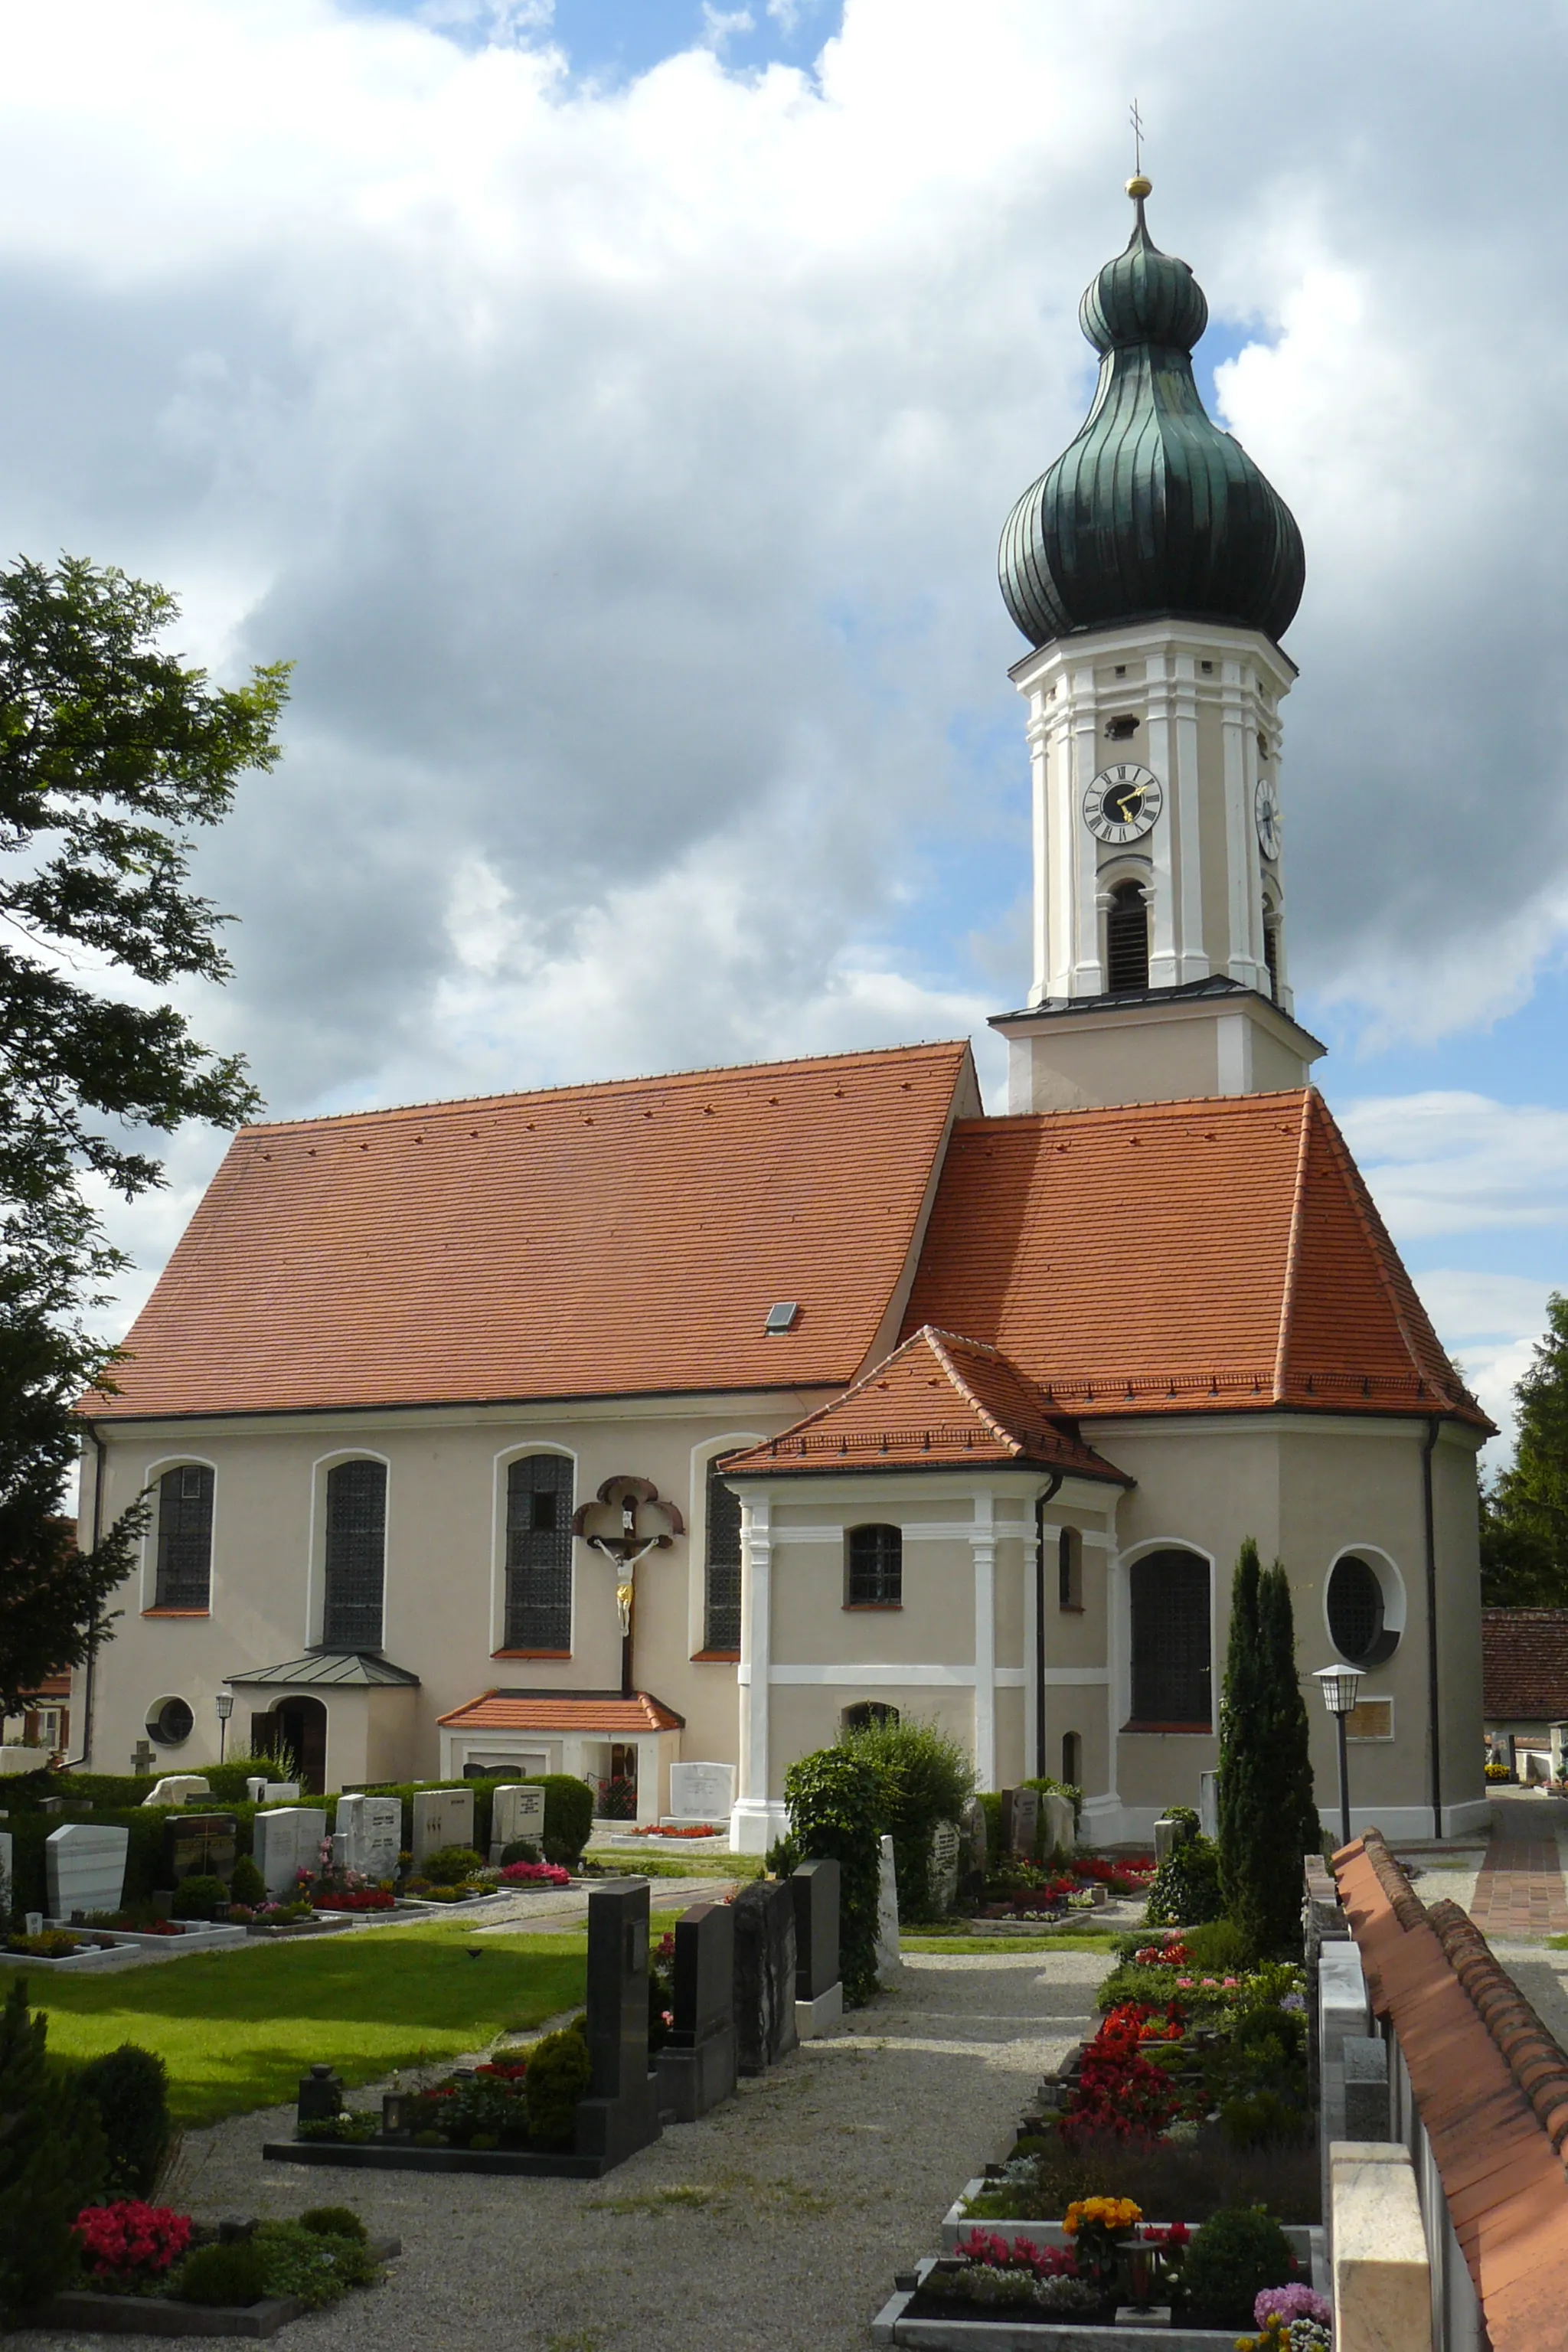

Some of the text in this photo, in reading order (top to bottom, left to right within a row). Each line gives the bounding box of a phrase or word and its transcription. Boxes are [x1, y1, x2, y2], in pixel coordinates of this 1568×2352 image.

[1133, 768, 1141, 781] I
[1089, 788, 1102, 798] X
[1146, 794, 1160, 803] III
[1119, 828, 1126, 841] VI
[1134, 823, 1145, 835] V
